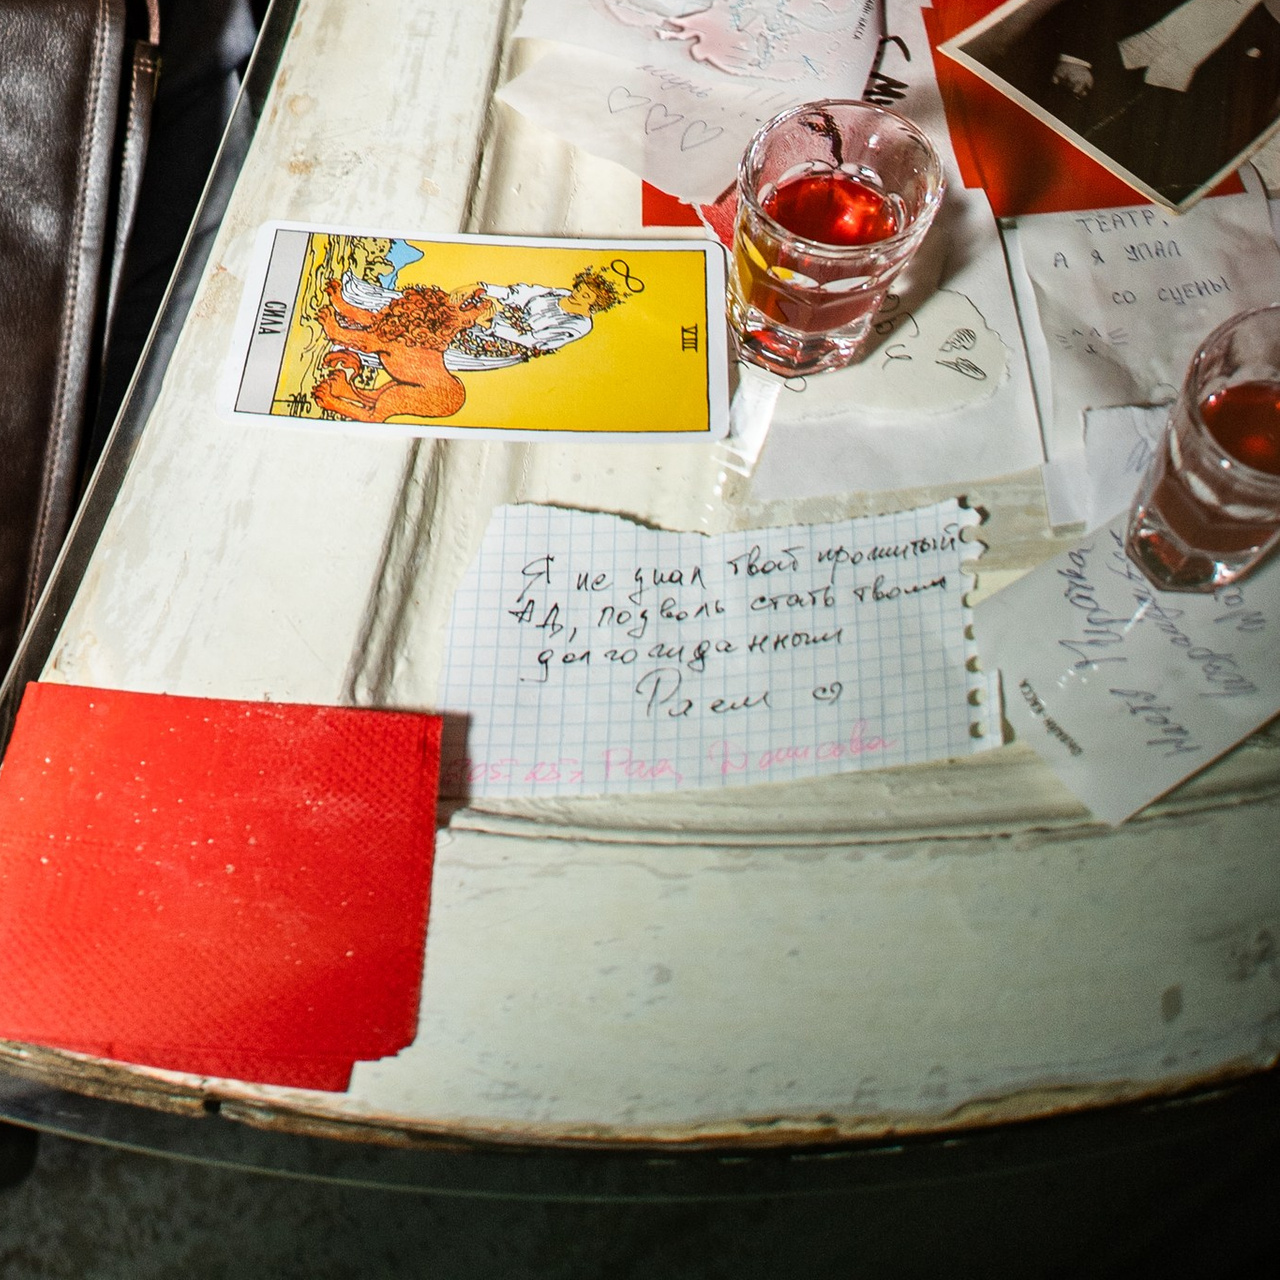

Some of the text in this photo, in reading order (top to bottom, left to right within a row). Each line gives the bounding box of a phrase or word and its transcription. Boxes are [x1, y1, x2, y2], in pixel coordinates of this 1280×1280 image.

[259, 300, 286, 337] СИЛА
[515, 554, 555, 603] Я
[750, 585, 836, 612] стать
